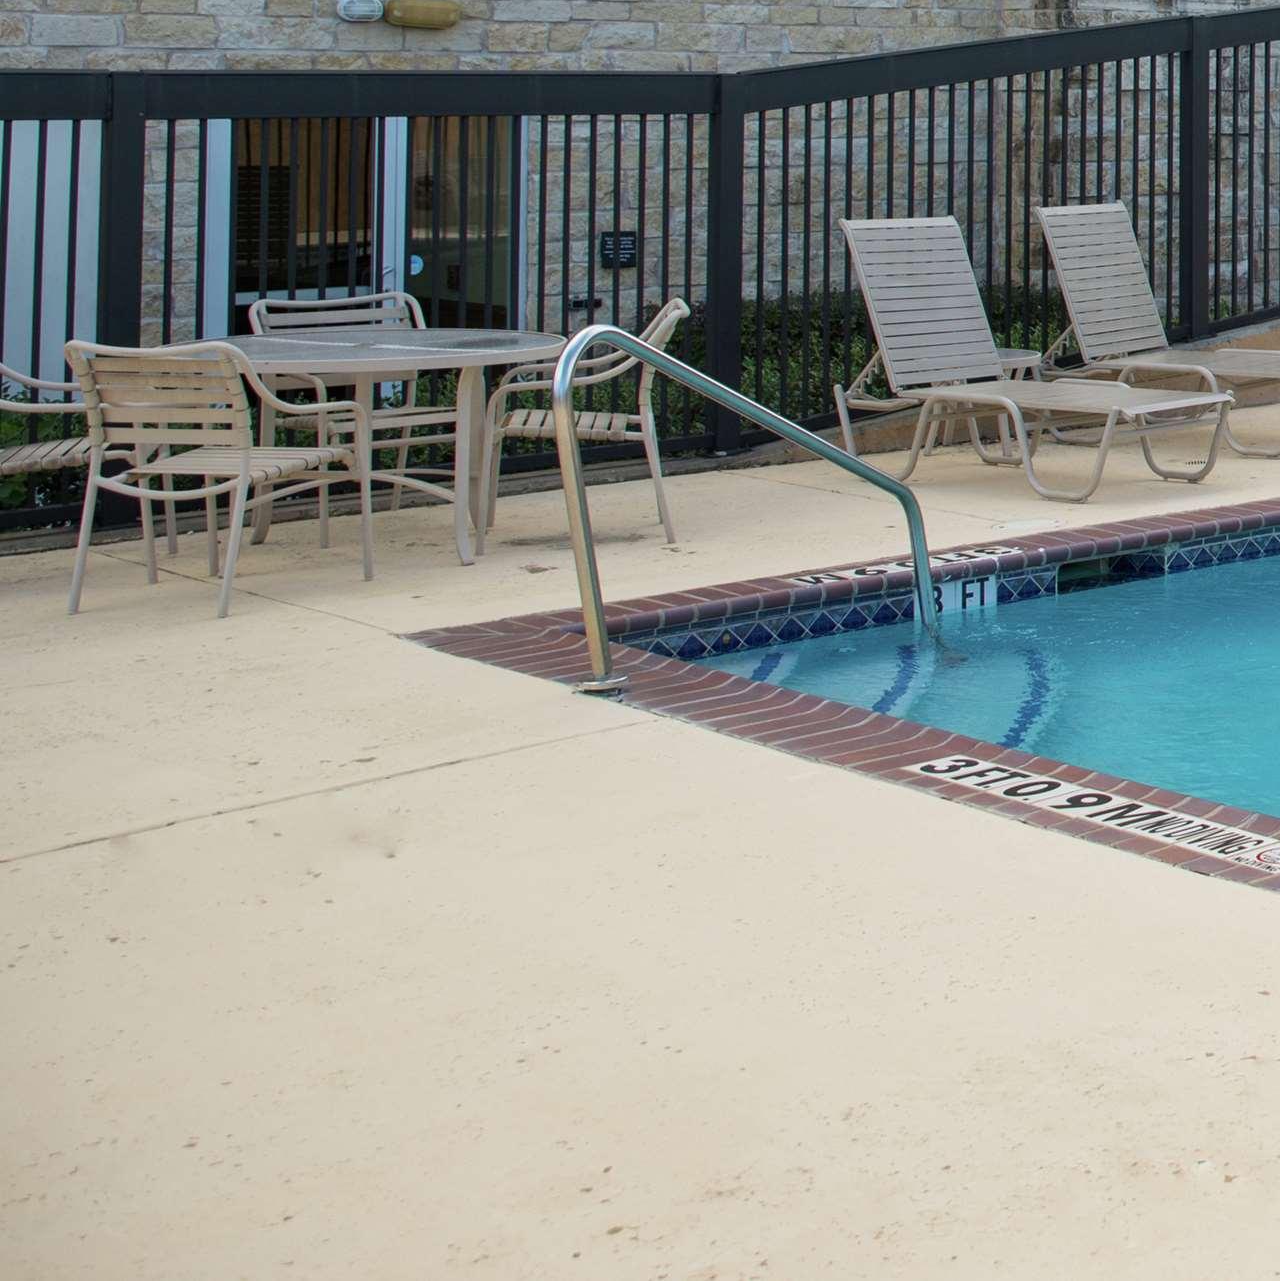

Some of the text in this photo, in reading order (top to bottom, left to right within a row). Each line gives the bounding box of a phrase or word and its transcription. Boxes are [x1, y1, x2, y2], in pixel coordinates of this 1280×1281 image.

[961, 576, 990, 610] FT
[920, 758, 980, 775] 3
[1085, 802, 1169, 828] M
[1135, 815, 1194, 835] NO
[1163, 822, 1265, 856] DIVING
